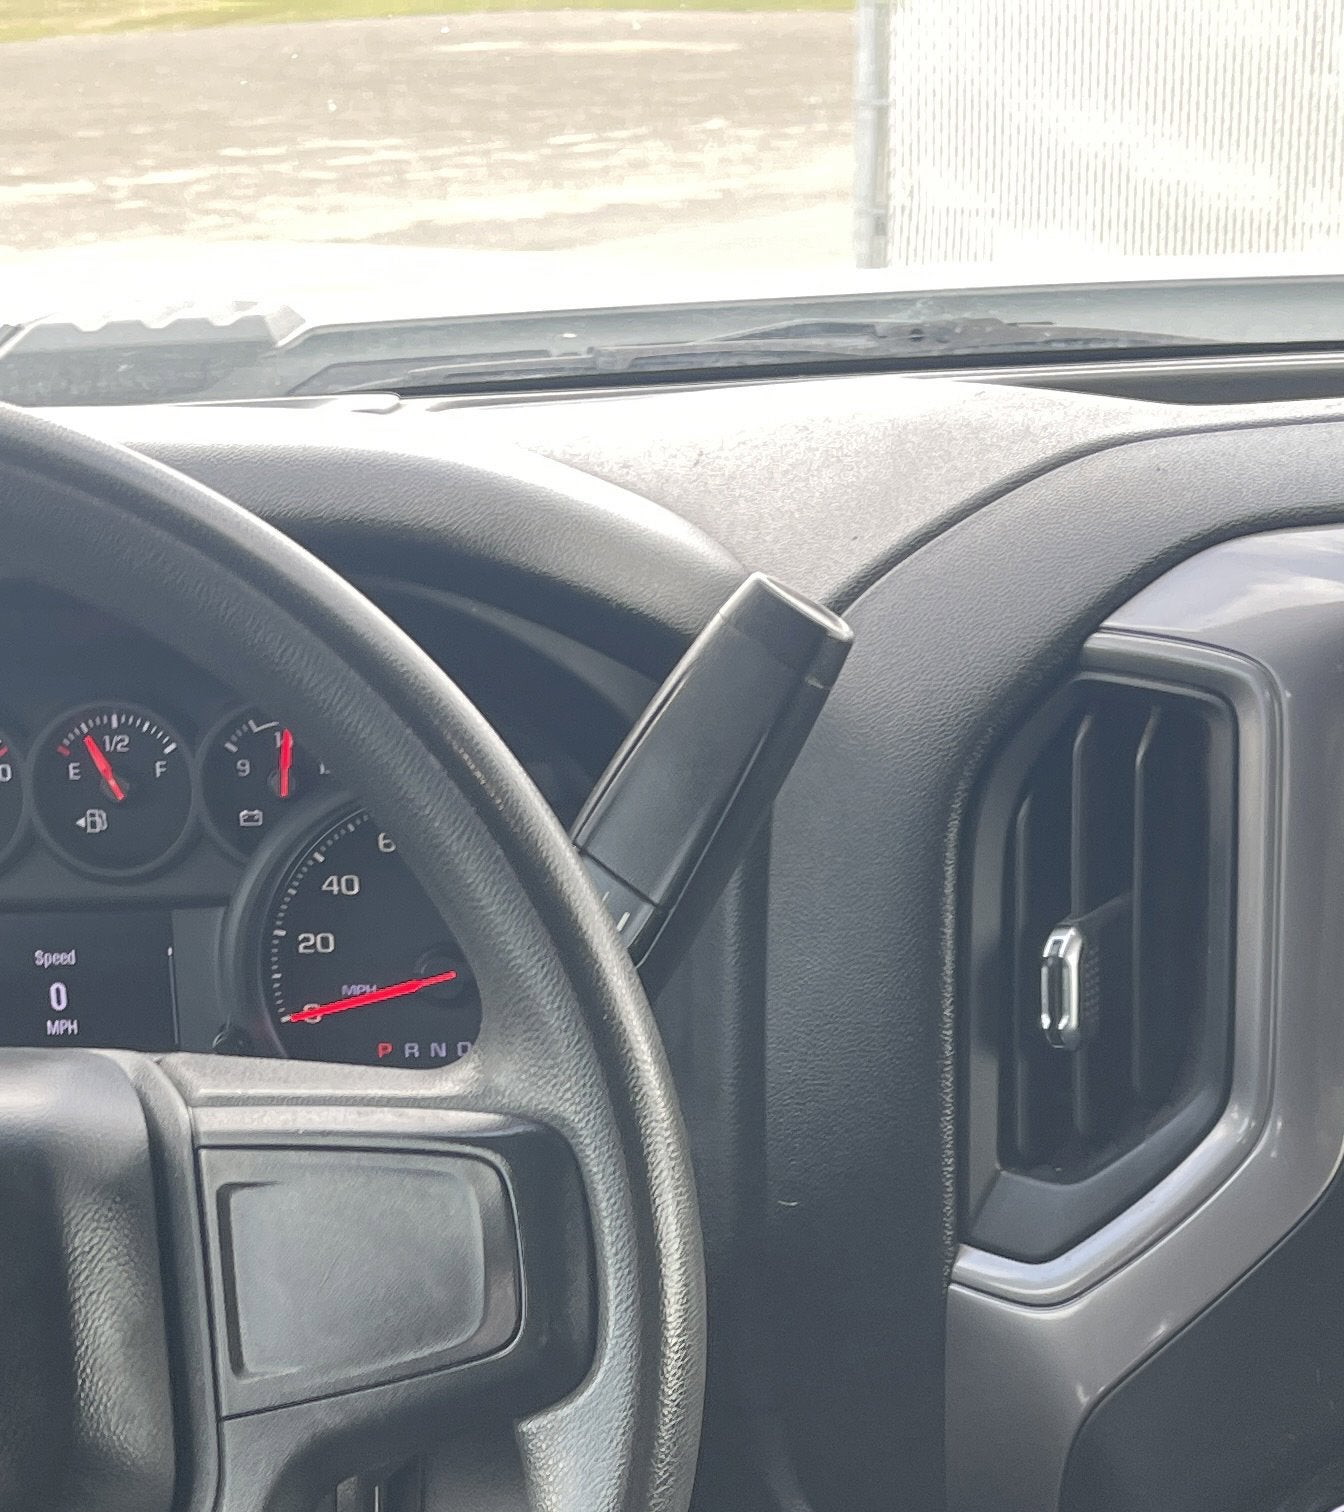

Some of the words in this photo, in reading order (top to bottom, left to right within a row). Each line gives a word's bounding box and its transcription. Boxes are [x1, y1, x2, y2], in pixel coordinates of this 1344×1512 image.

[104, 735, 130, 753] 1/2
[68, 762, 81, 781] E
[156, 761, 168, 778] F
[236, 759, 251, 777] 9
[377, 832, 396, 853] 6
[321, 874, 360, 896] 40
[297, 932, 335, 953] 20
[34, 949, 77, 969] Speed
[49, 981, 68, 1011] 0
[341, 984, 377, 997] MPH
[46, 1019, 78, 1035] MPH
[377, 1043, 393, 1058] P
[404, 1042, 420, 1058] R
[430, 1043, 447, 1058] N
